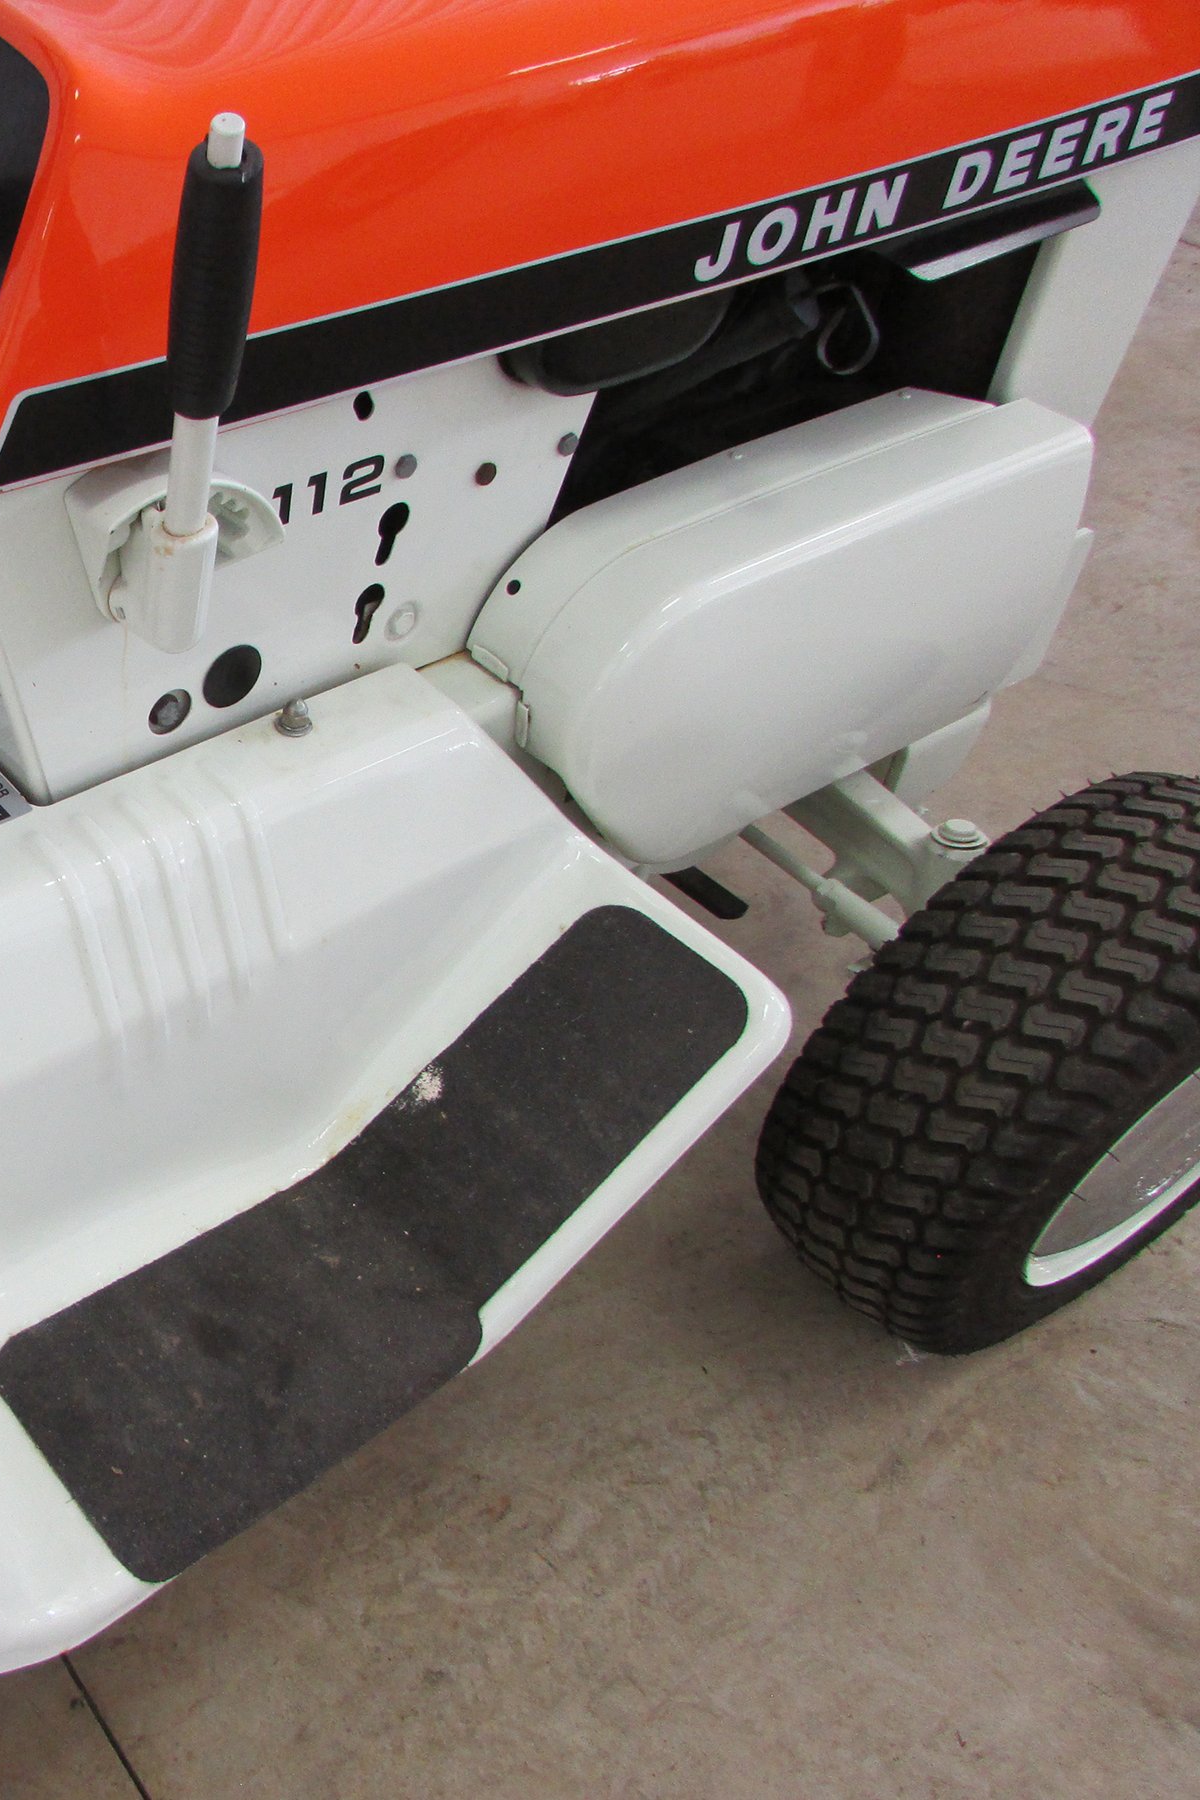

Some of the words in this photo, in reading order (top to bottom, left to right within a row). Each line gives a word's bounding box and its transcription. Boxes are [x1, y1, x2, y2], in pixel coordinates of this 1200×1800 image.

[694, 173, 906, 282] JOHN
[942, 90, 1175, 209] DEERE
[271, 454, 385, 525] 112
